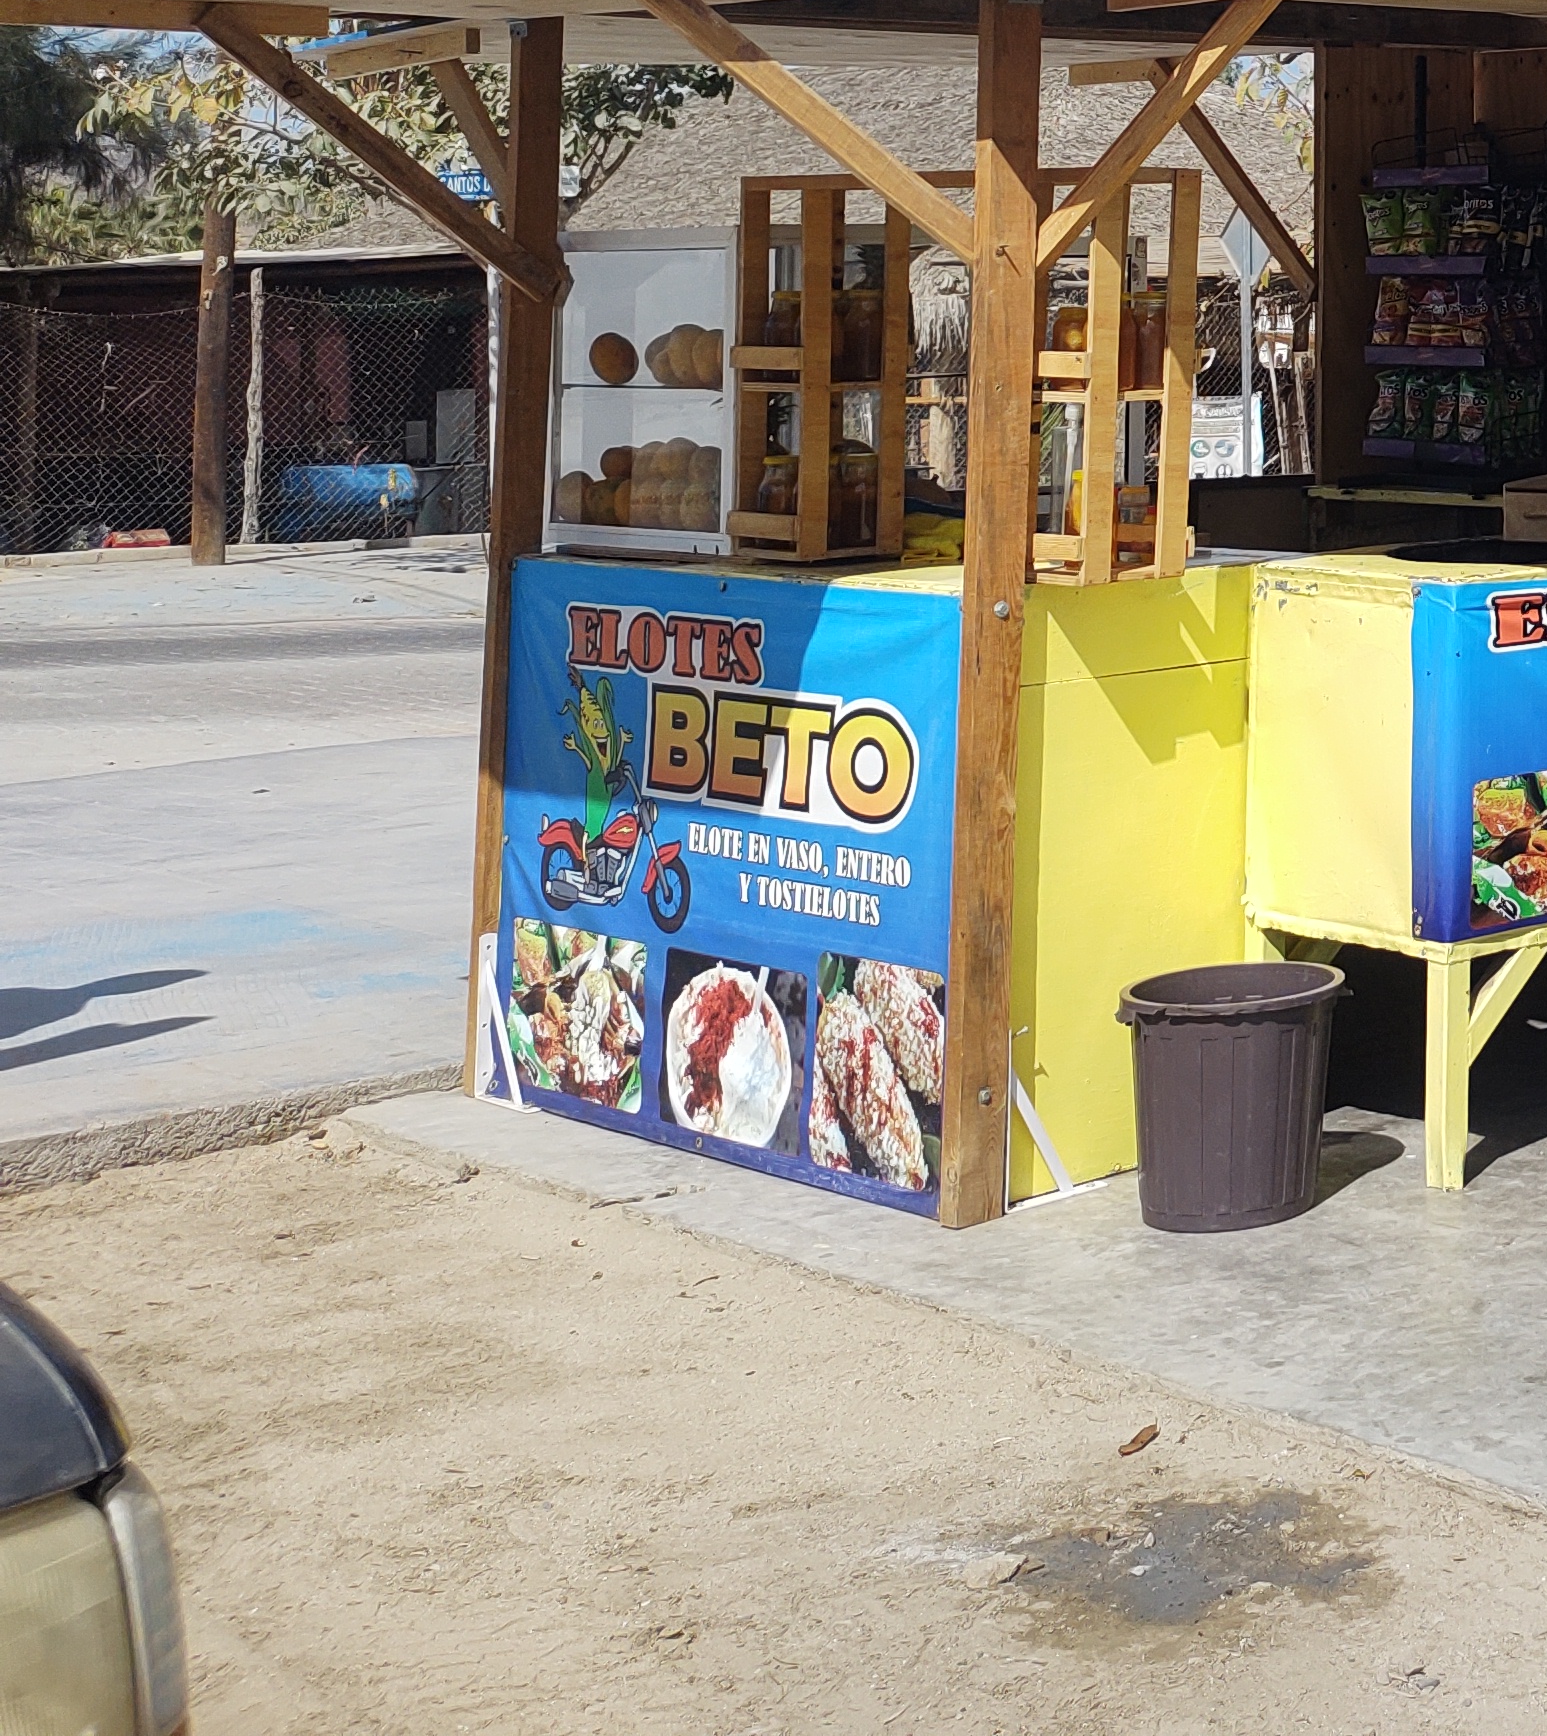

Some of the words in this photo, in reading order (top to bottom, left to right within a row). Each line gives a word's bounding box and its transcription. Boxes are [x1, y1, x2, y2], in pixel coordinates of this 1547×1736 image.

[567, 606, 763, 684] ELOTES
[648, 683, 917, 825] BETO
[688, 822, 744, 860] ELOTE
[747, 832, 771, 865] EN
[776, 836, 829, 879] VASO,
[835, 845, 912, 888] ENTERO
[739, 872, 752, 904] Y
[757, 875, 881, 927] TOSTIELOTES
